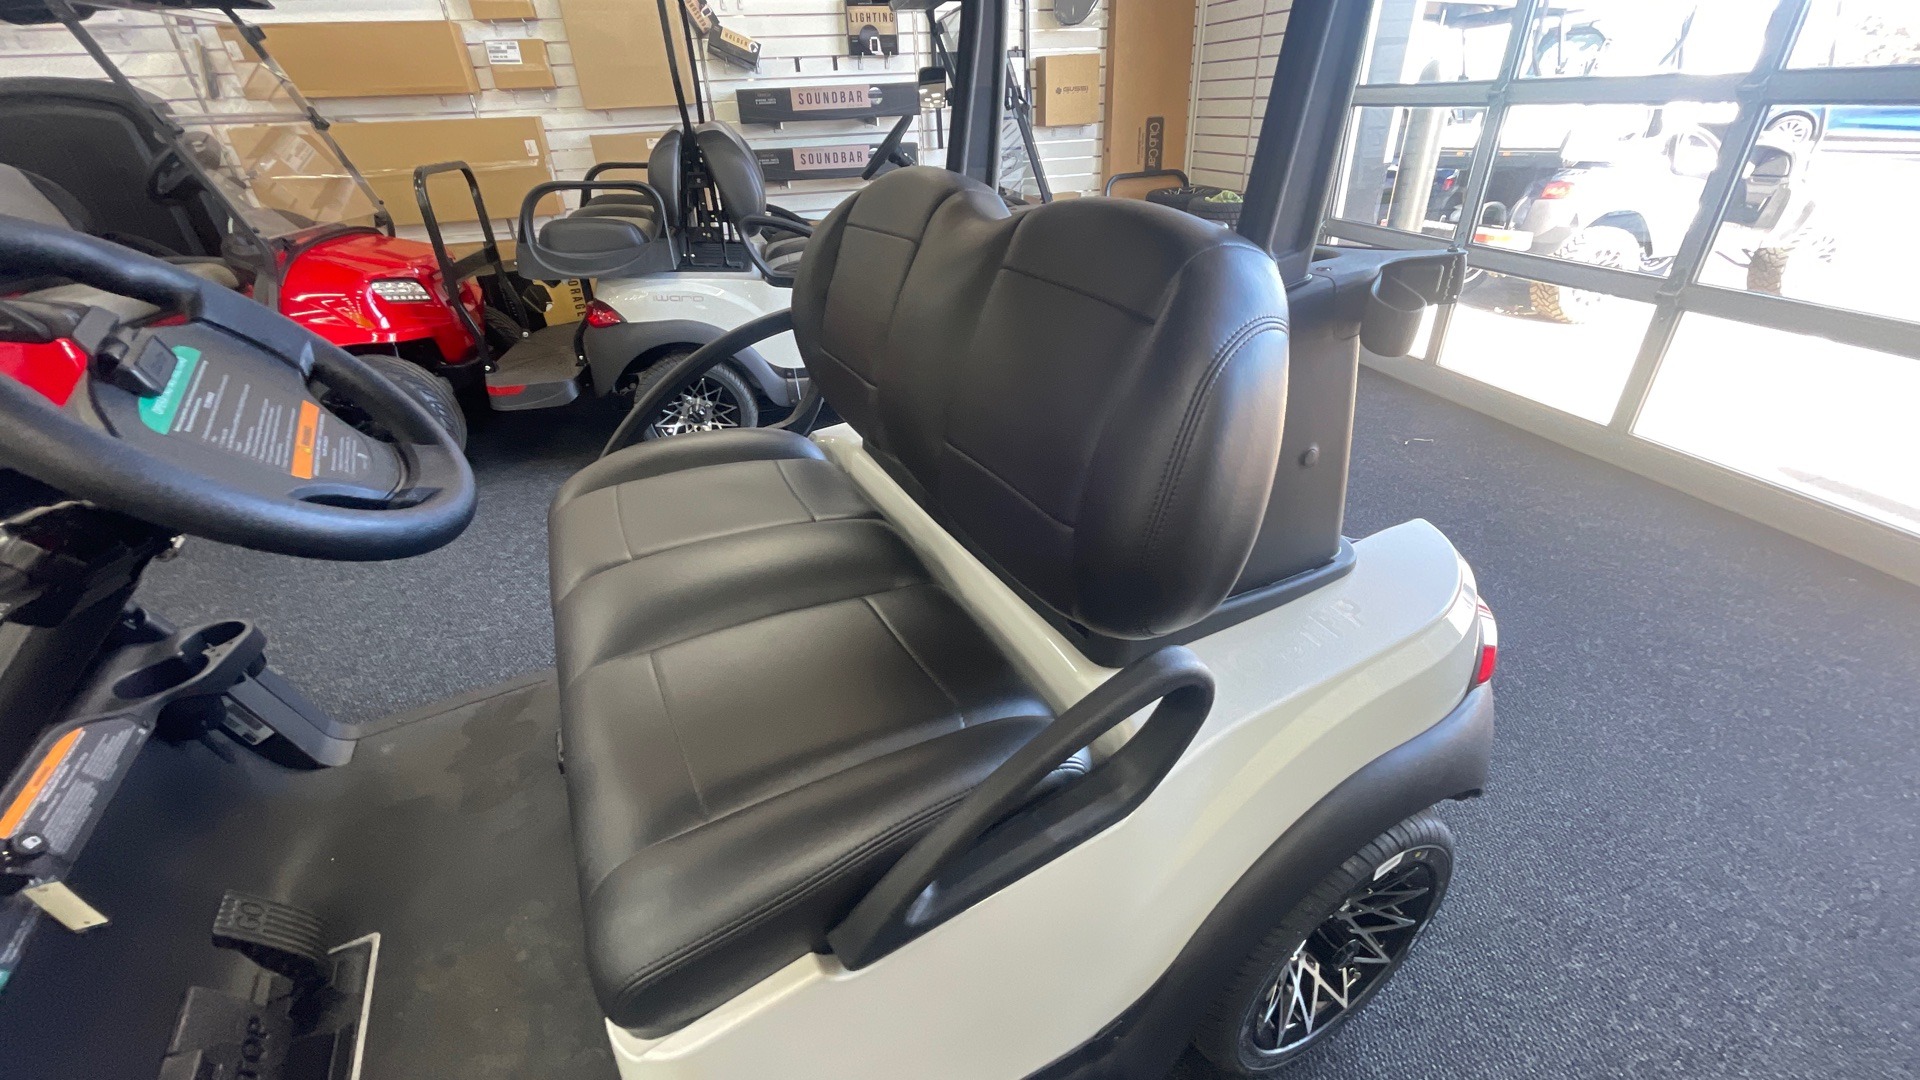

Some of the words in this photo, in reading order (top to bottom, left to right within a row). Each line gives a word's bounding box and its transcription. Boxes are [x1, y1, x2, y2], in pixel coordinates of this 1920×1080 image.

[850, 12, 894, 23] LIGHTING
[798, 90, 863, 105] SOUNDBAR
[1149, 122, 1160, 147] Club
[800, 151, 863, 165] SOUNDBAR
[1148, 148, 1159, 168] Car
[567, 280, 587, 317] ORAGE
